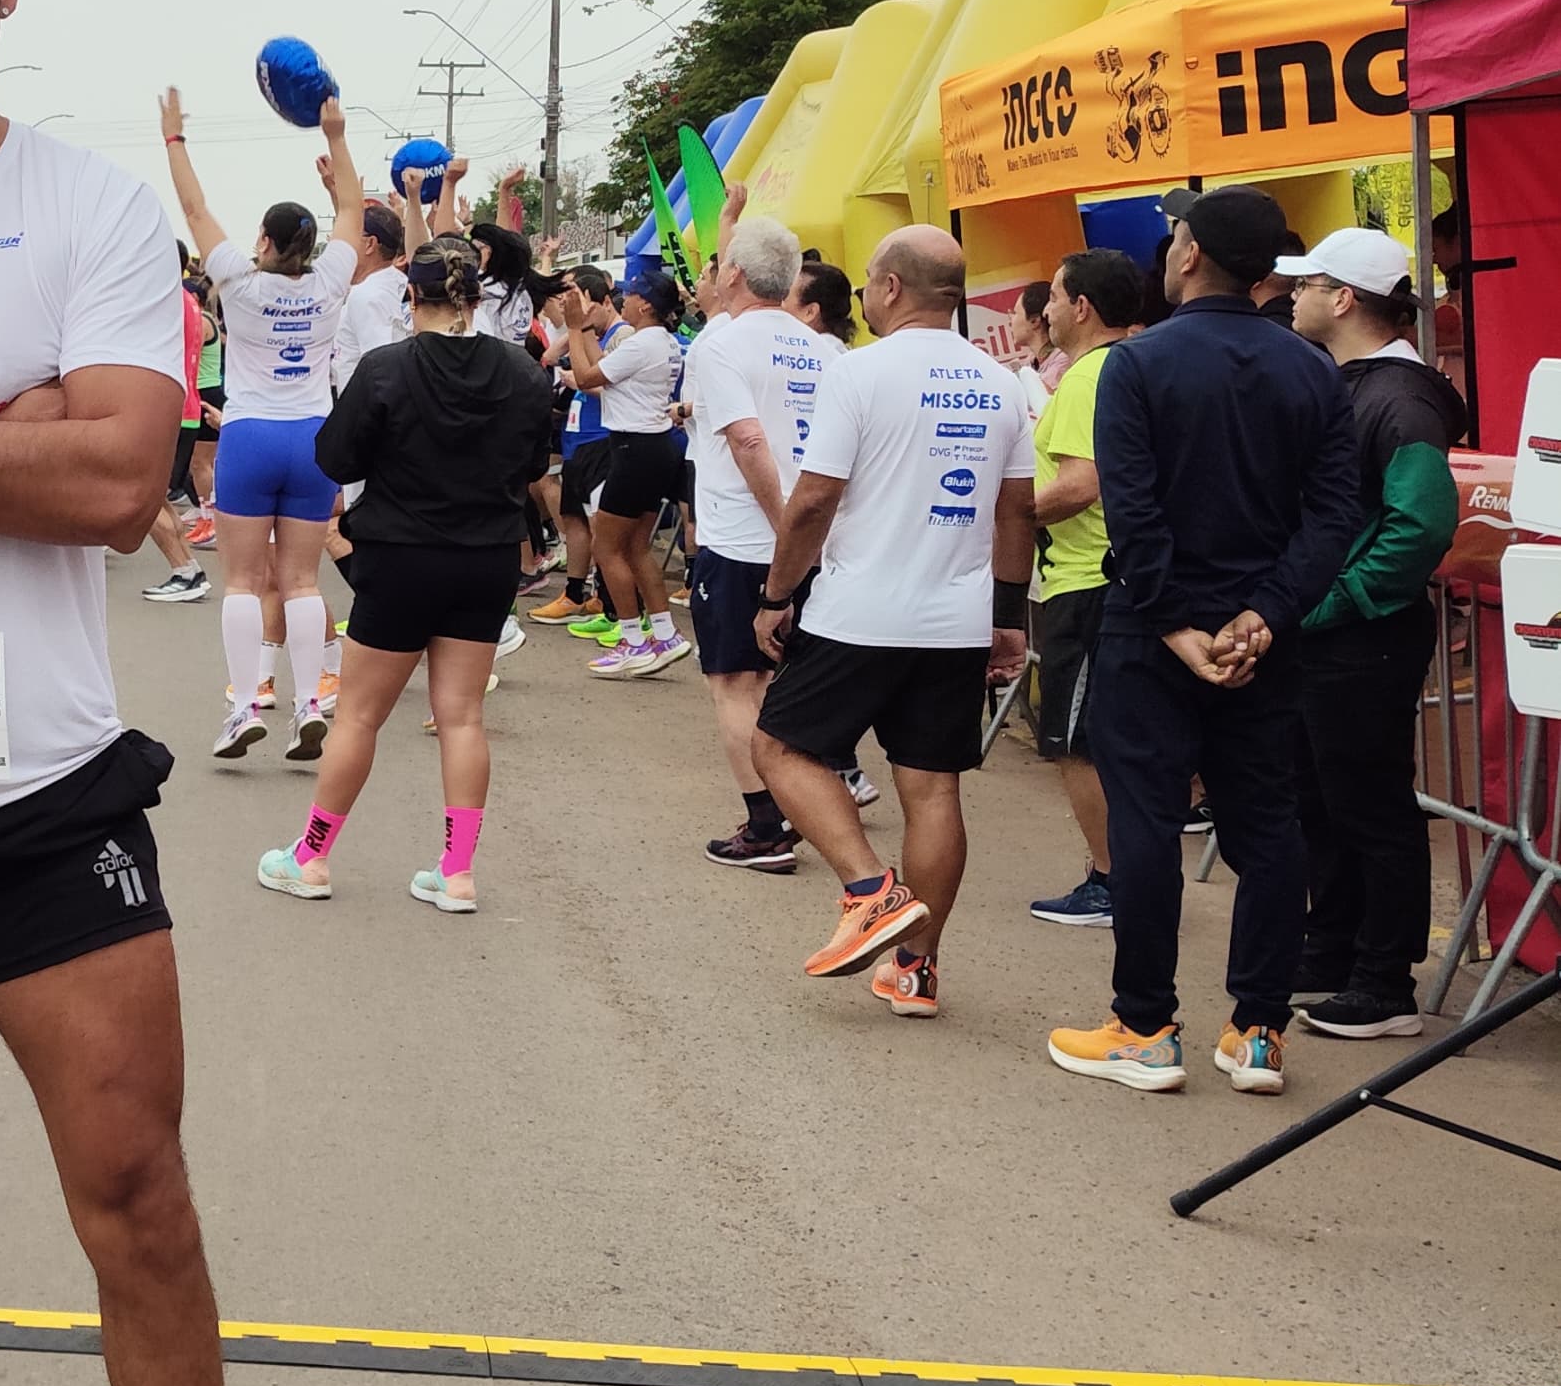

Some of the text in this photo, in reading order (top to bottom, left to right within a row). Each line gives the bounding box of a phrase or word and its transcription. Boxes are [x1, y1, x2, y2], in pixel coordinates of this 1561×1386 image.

[929, 368, 983, 380] ATLETA
[920, 389, 1001, 411] MISSÕES
[929, 447, 951, 457] DVG
[944, 476, 975, 488] Blukit
[305, 815, 333, 853] RUN
